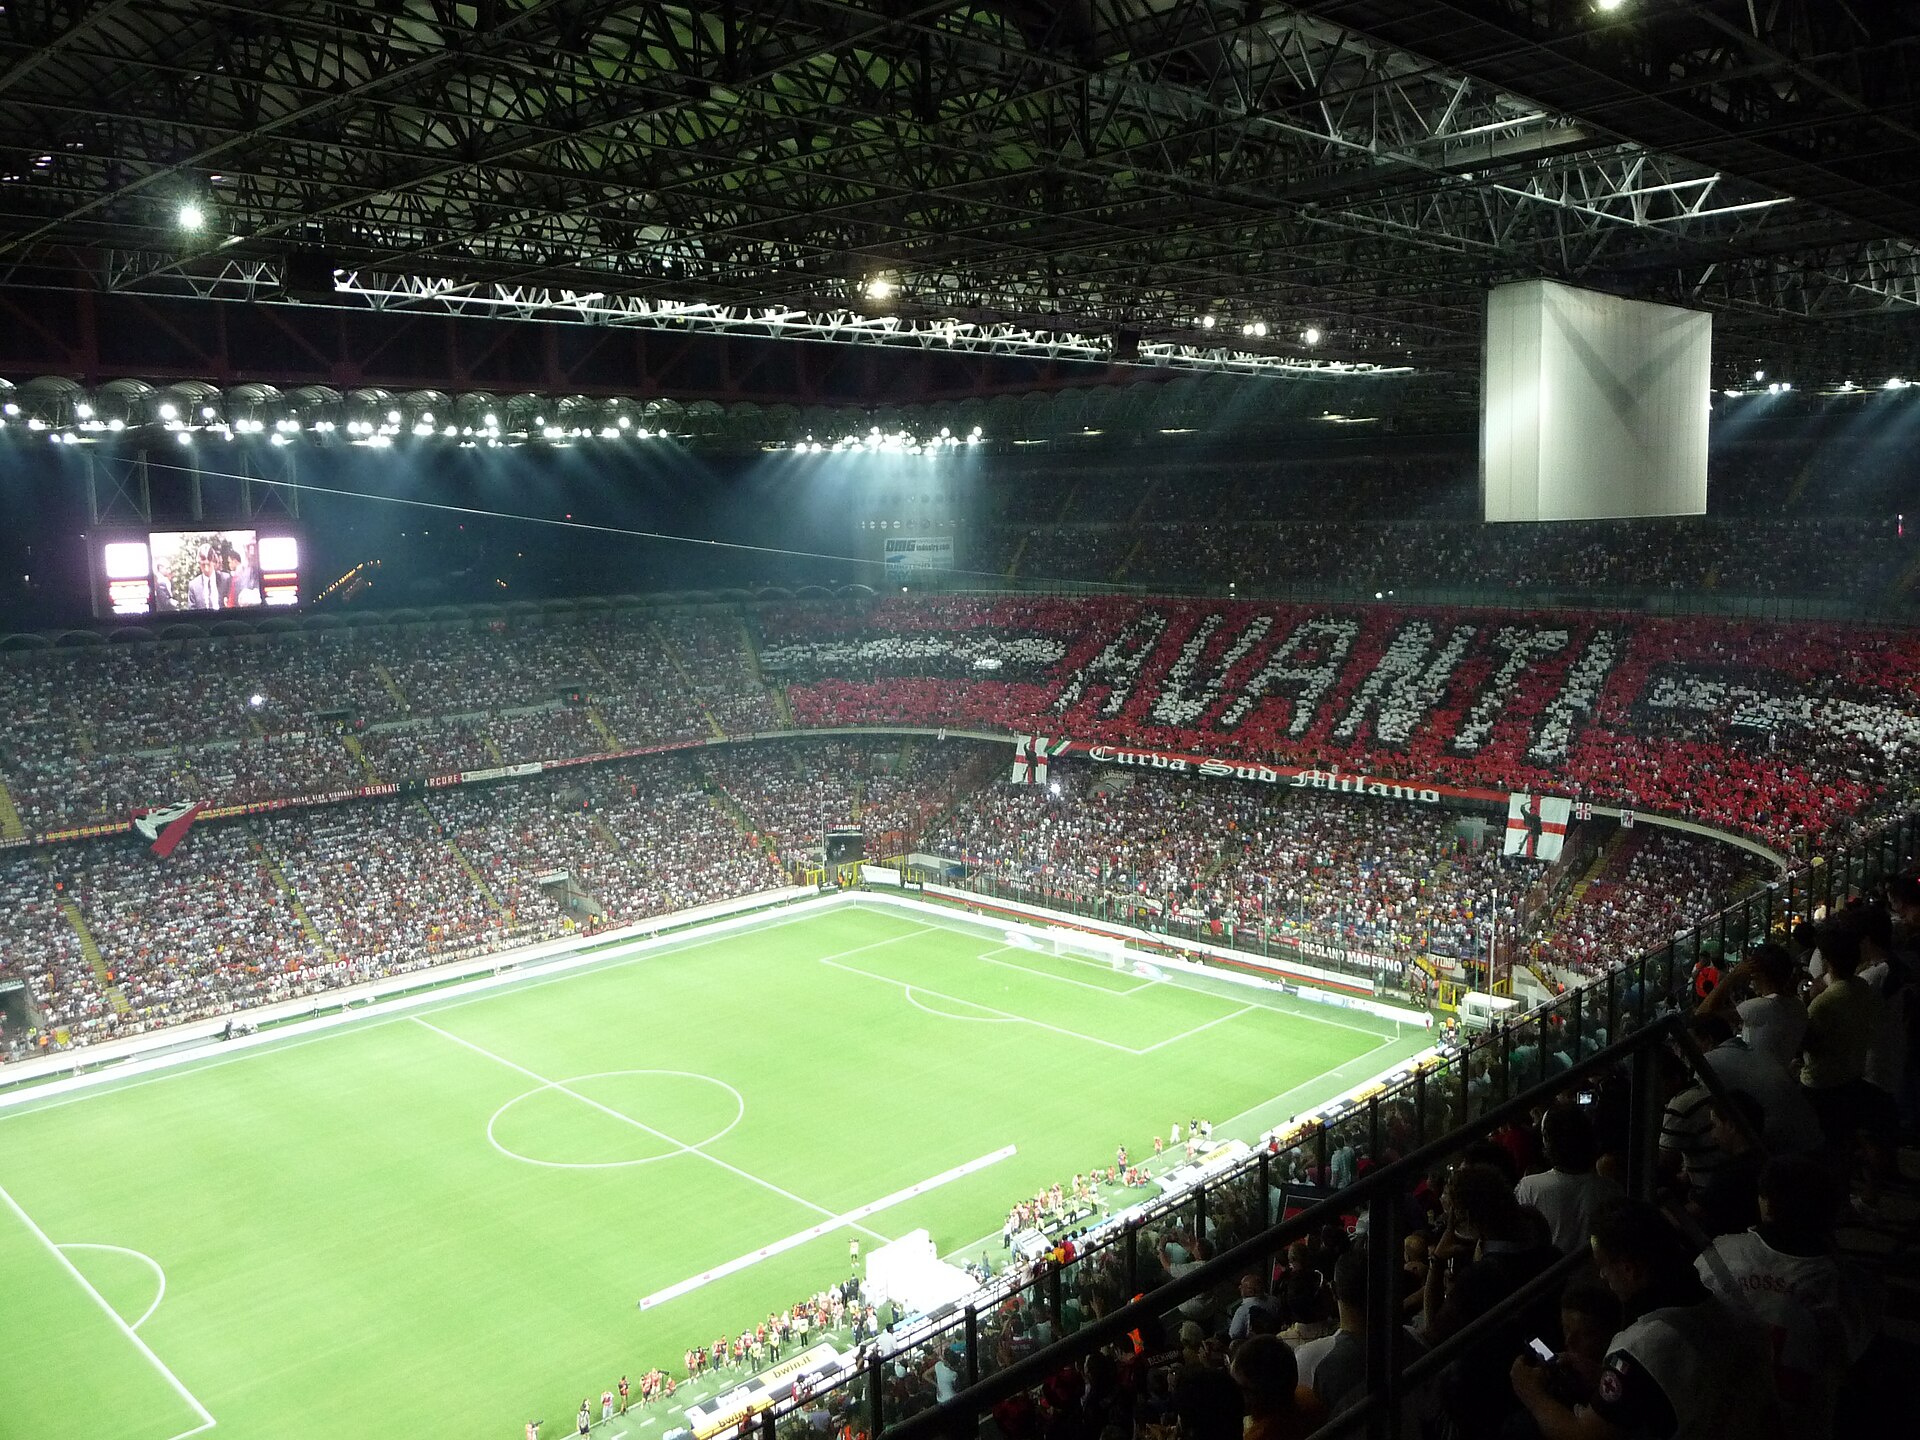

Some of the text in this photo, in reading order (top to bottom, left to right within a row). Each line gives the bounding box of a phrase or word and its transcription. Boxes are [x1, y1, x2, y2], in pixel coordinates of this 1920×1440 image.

[1052, 608, 1618, 766] AVANTI
[365, 774, 458, 796] BERNATE ARCORE
[1089, 745, 1440, 803] Curva Sud Milano
[1346, 950, 1403, 973] MADERNO
[773, 1355, 811, 1379] bwin.it
